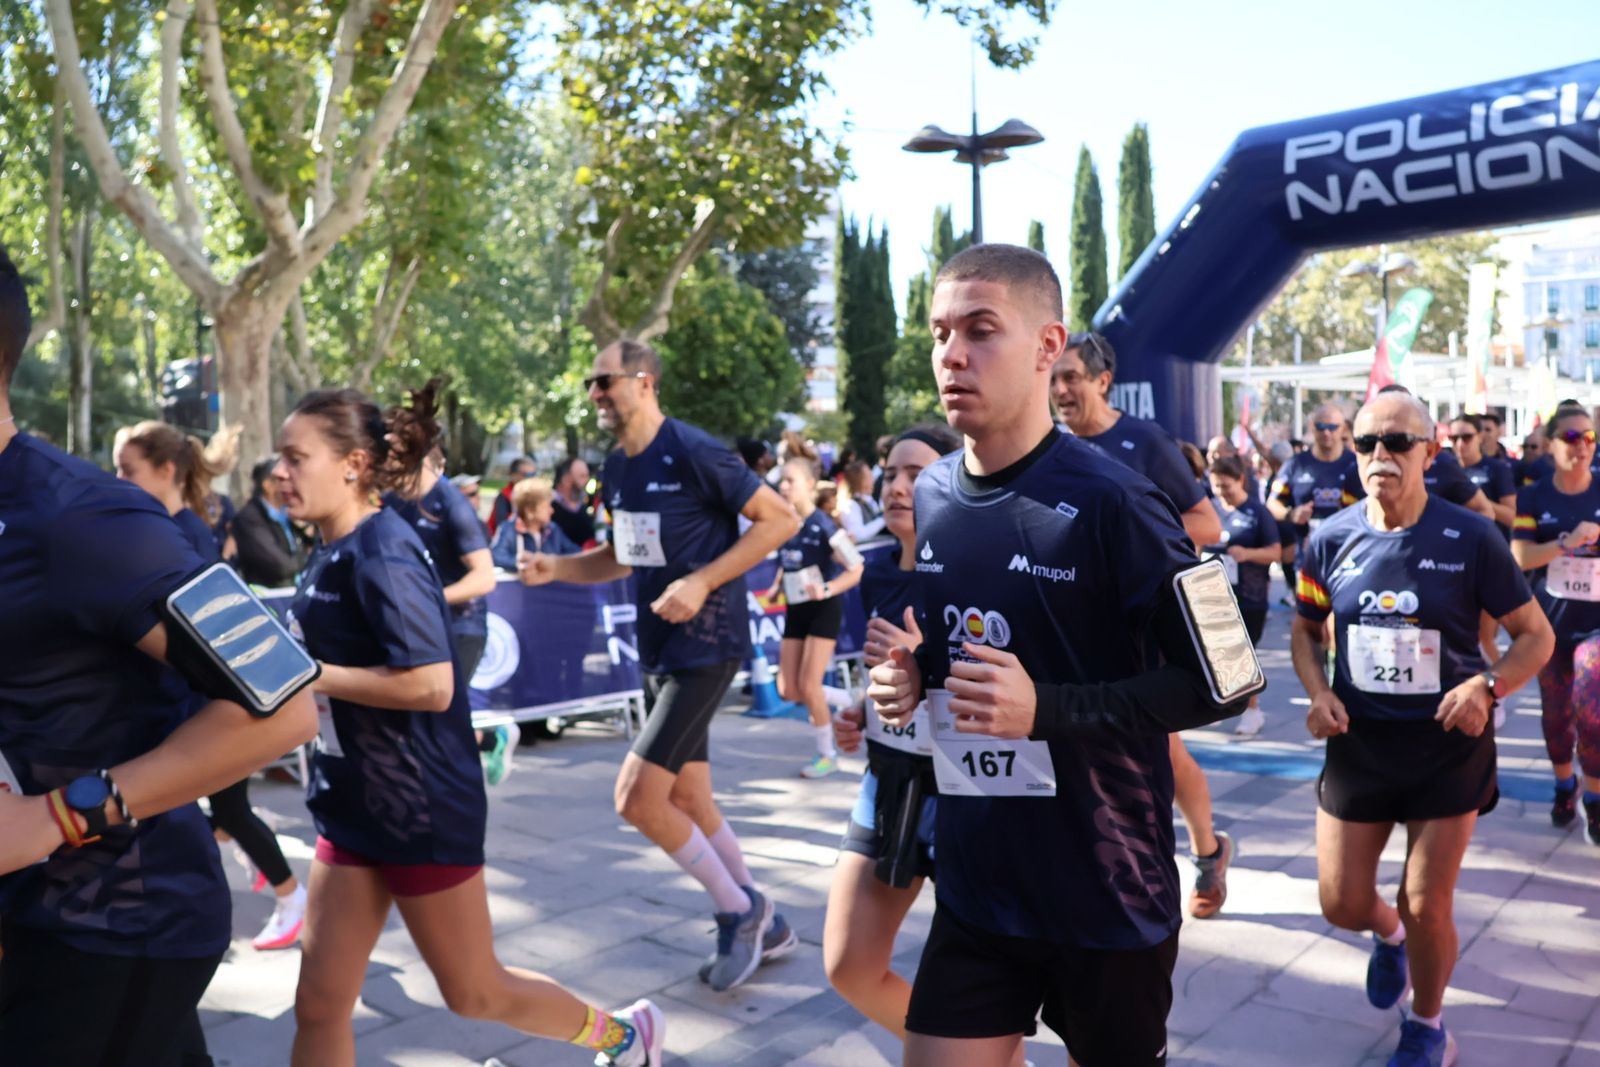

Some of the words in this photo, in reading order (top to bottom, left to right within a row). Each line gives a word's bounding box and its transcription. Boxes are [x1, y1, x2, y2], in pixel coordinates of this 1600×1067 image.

[1032, 564, 1075, 582] mupol
[1437, 562, 1465, 573] mupol
[1564, 581, 1591, 593] 105
[1374, 666, 1414, 683] 221
[962, 751, 1016, 777] 167
